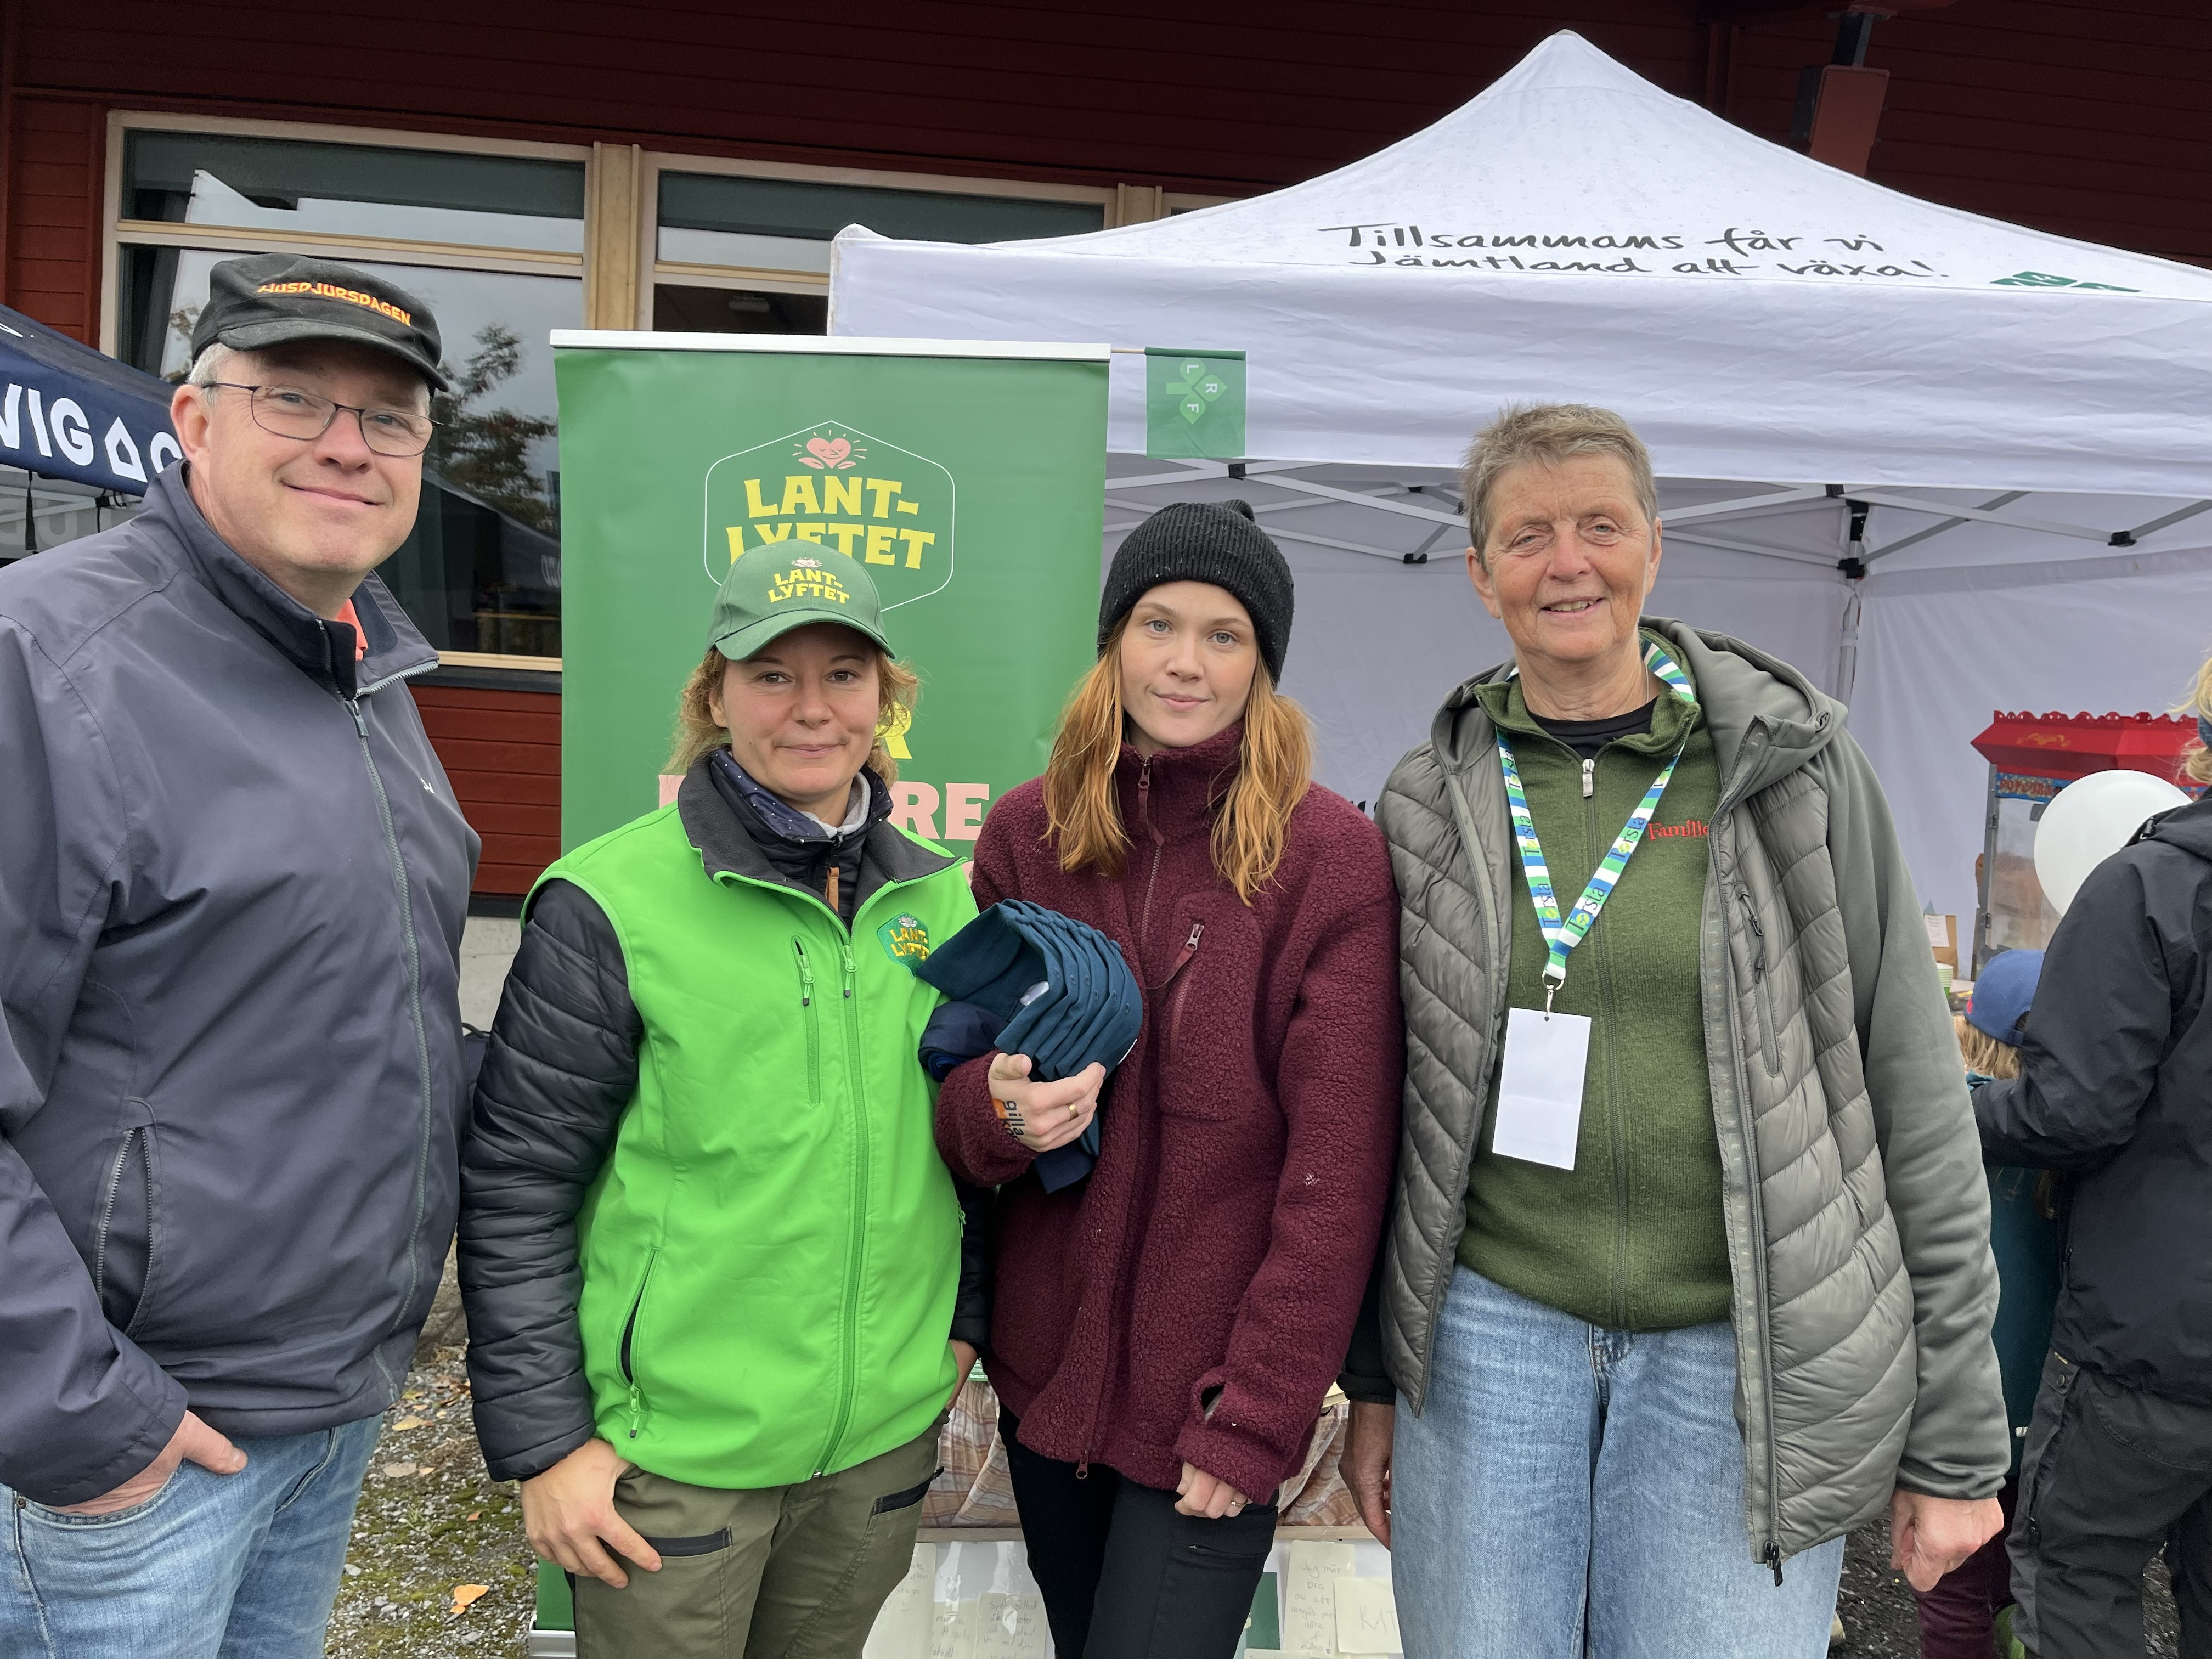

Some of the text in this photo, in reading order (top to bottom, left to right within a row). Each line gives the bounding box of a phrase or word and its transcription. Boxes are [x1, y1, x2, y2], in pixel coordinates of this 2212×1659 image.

[1317, 223, 1884, 257] Tillsammans får vi
[1347, 251, 1949, 277] Jämtland att växa!
[743, 476, 919, 518] LANT-
[768, 583, 850, 605] LYFTET
[774, 569, 843, 589] LANT-
[1607, 817, 1646, 859] Torsta
[1536, 883, 1560, 927] Torsta
[1565, 886, 1607, 932] Torsta
